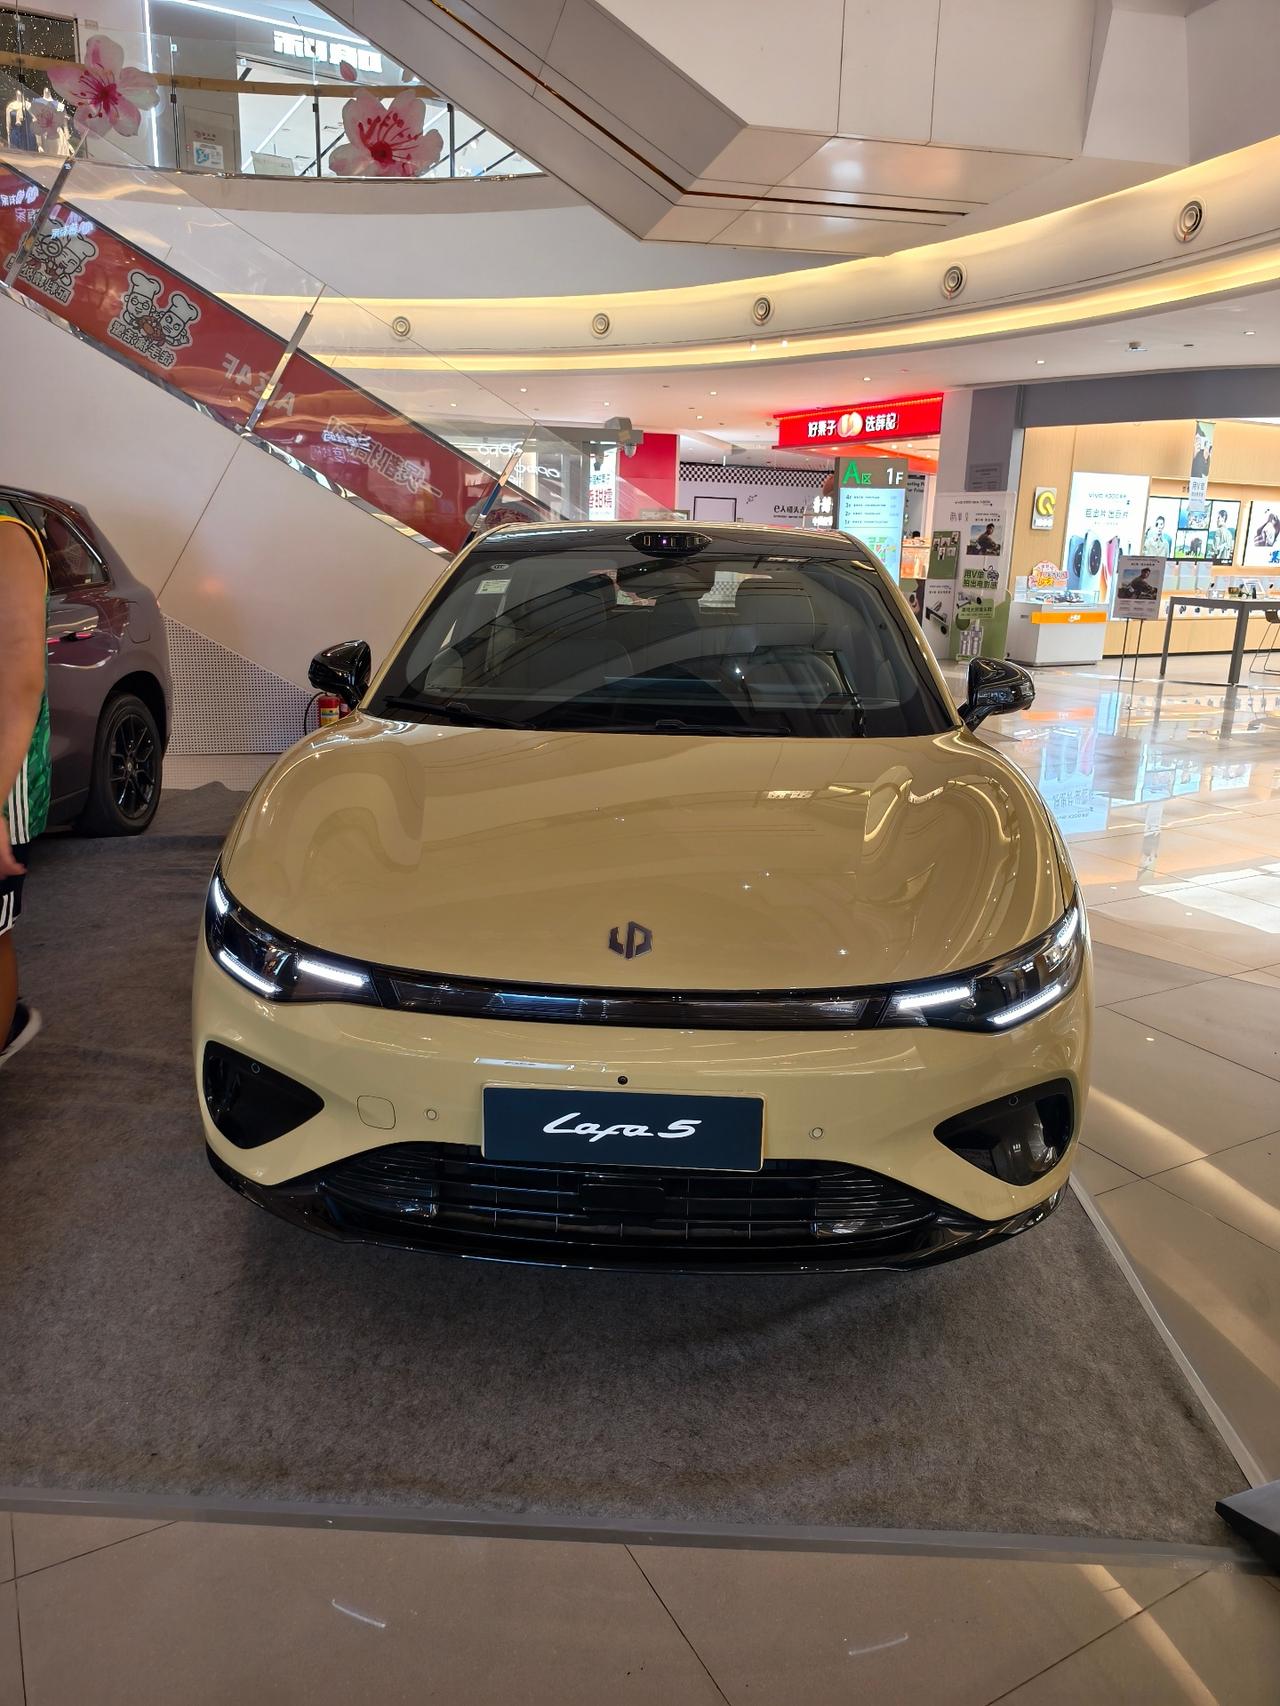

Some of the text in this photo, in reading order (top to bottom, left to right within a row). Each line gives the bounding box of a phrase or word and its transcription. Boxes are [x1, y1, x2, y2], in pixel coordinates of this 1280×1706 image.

[842, 460, 903, 485] A区 1F
[542, 1112, 702, 1142] Lafa 5
